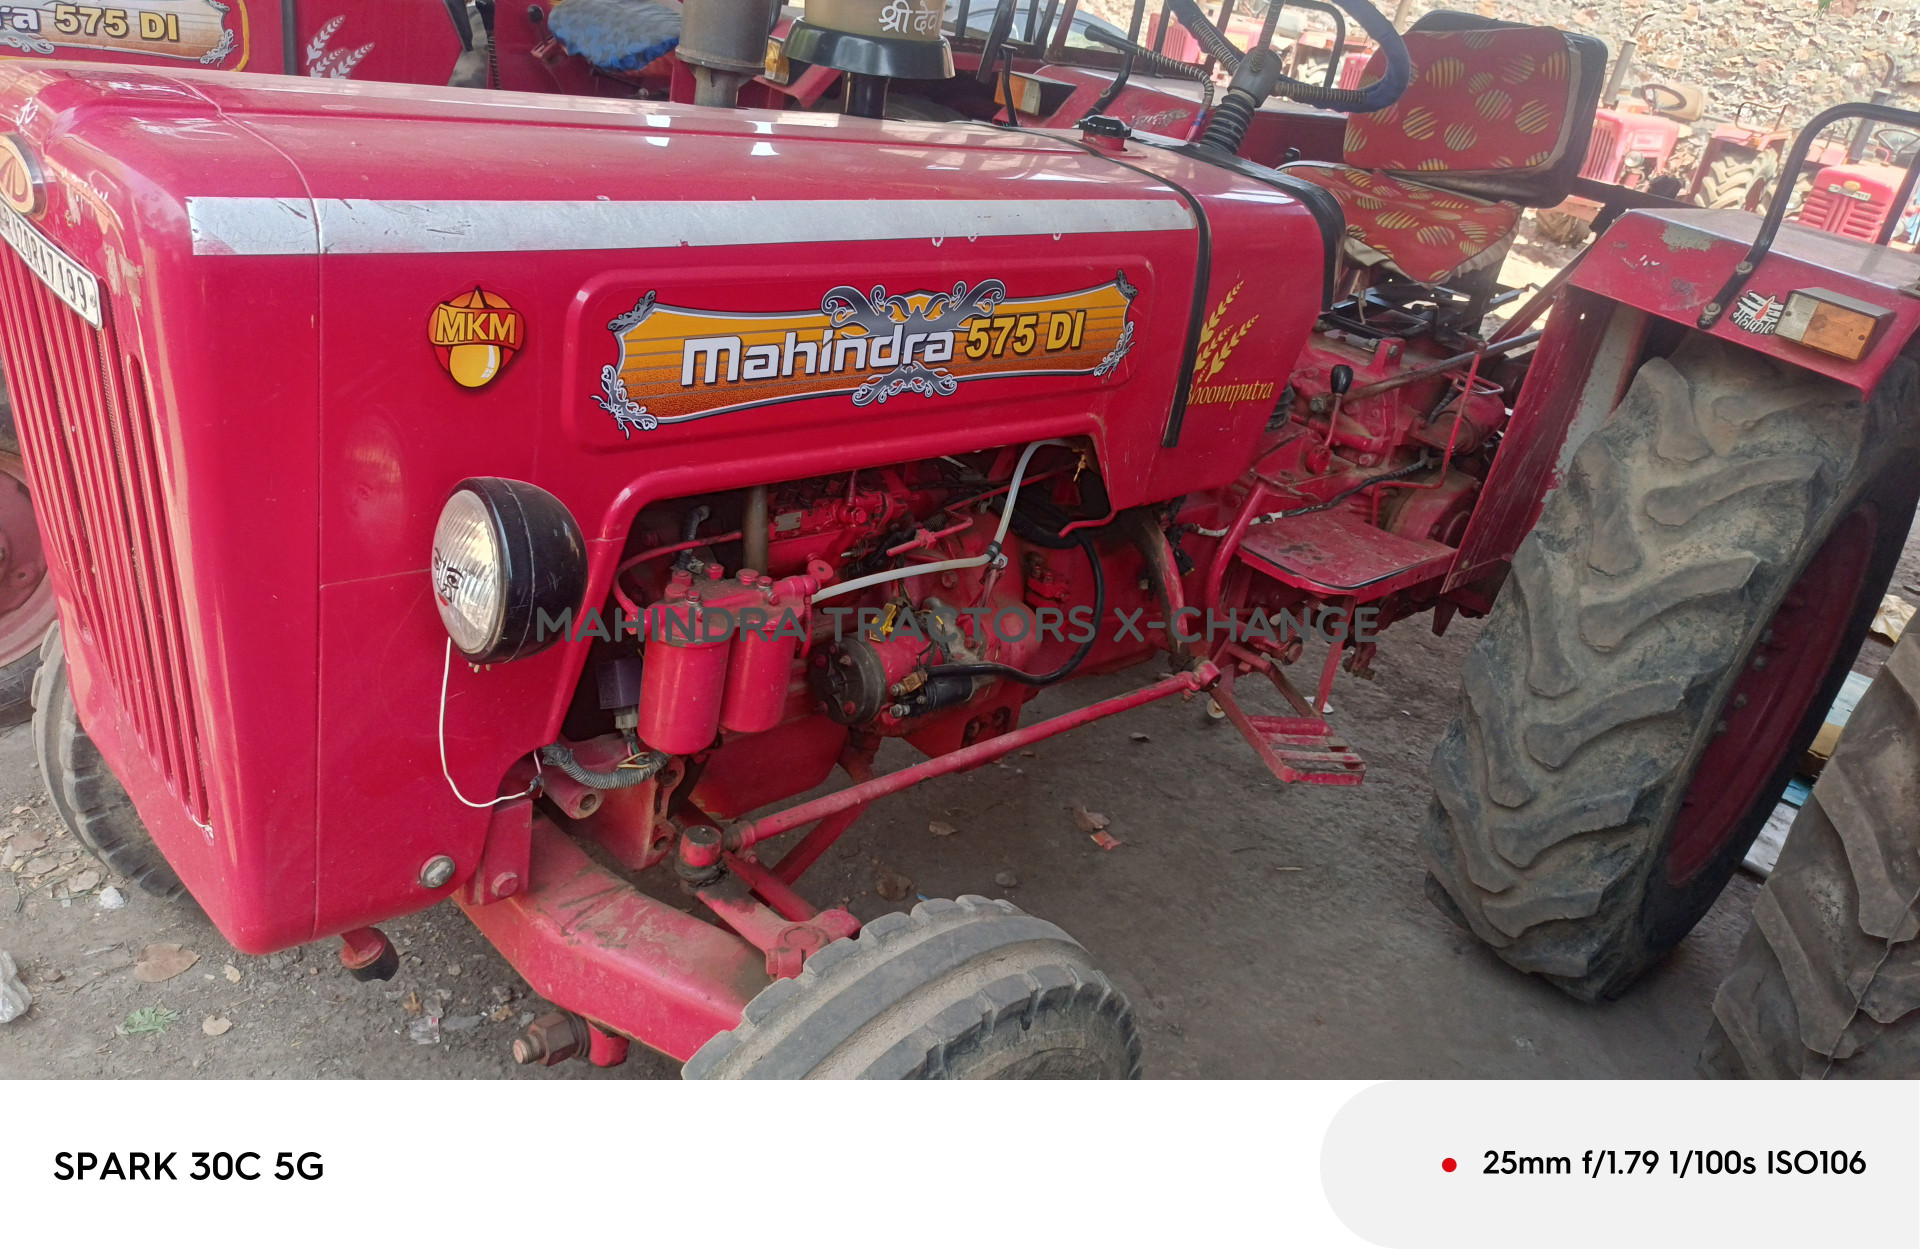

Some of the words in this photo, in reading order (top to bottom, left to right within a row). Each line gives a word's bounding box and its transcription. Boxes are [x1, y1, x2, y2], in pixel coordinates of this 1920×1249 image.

[55, 4, 128, 36] 575
[139, 11, 180, 41] DI
[879, 0, 913, 33] श्री
[435, 306, 517, 346] MKM
[681, 323, 955, 387] Mahindra
[964, 315, 1037, 358] 575
[1045, 310, 1087, 351] DI
